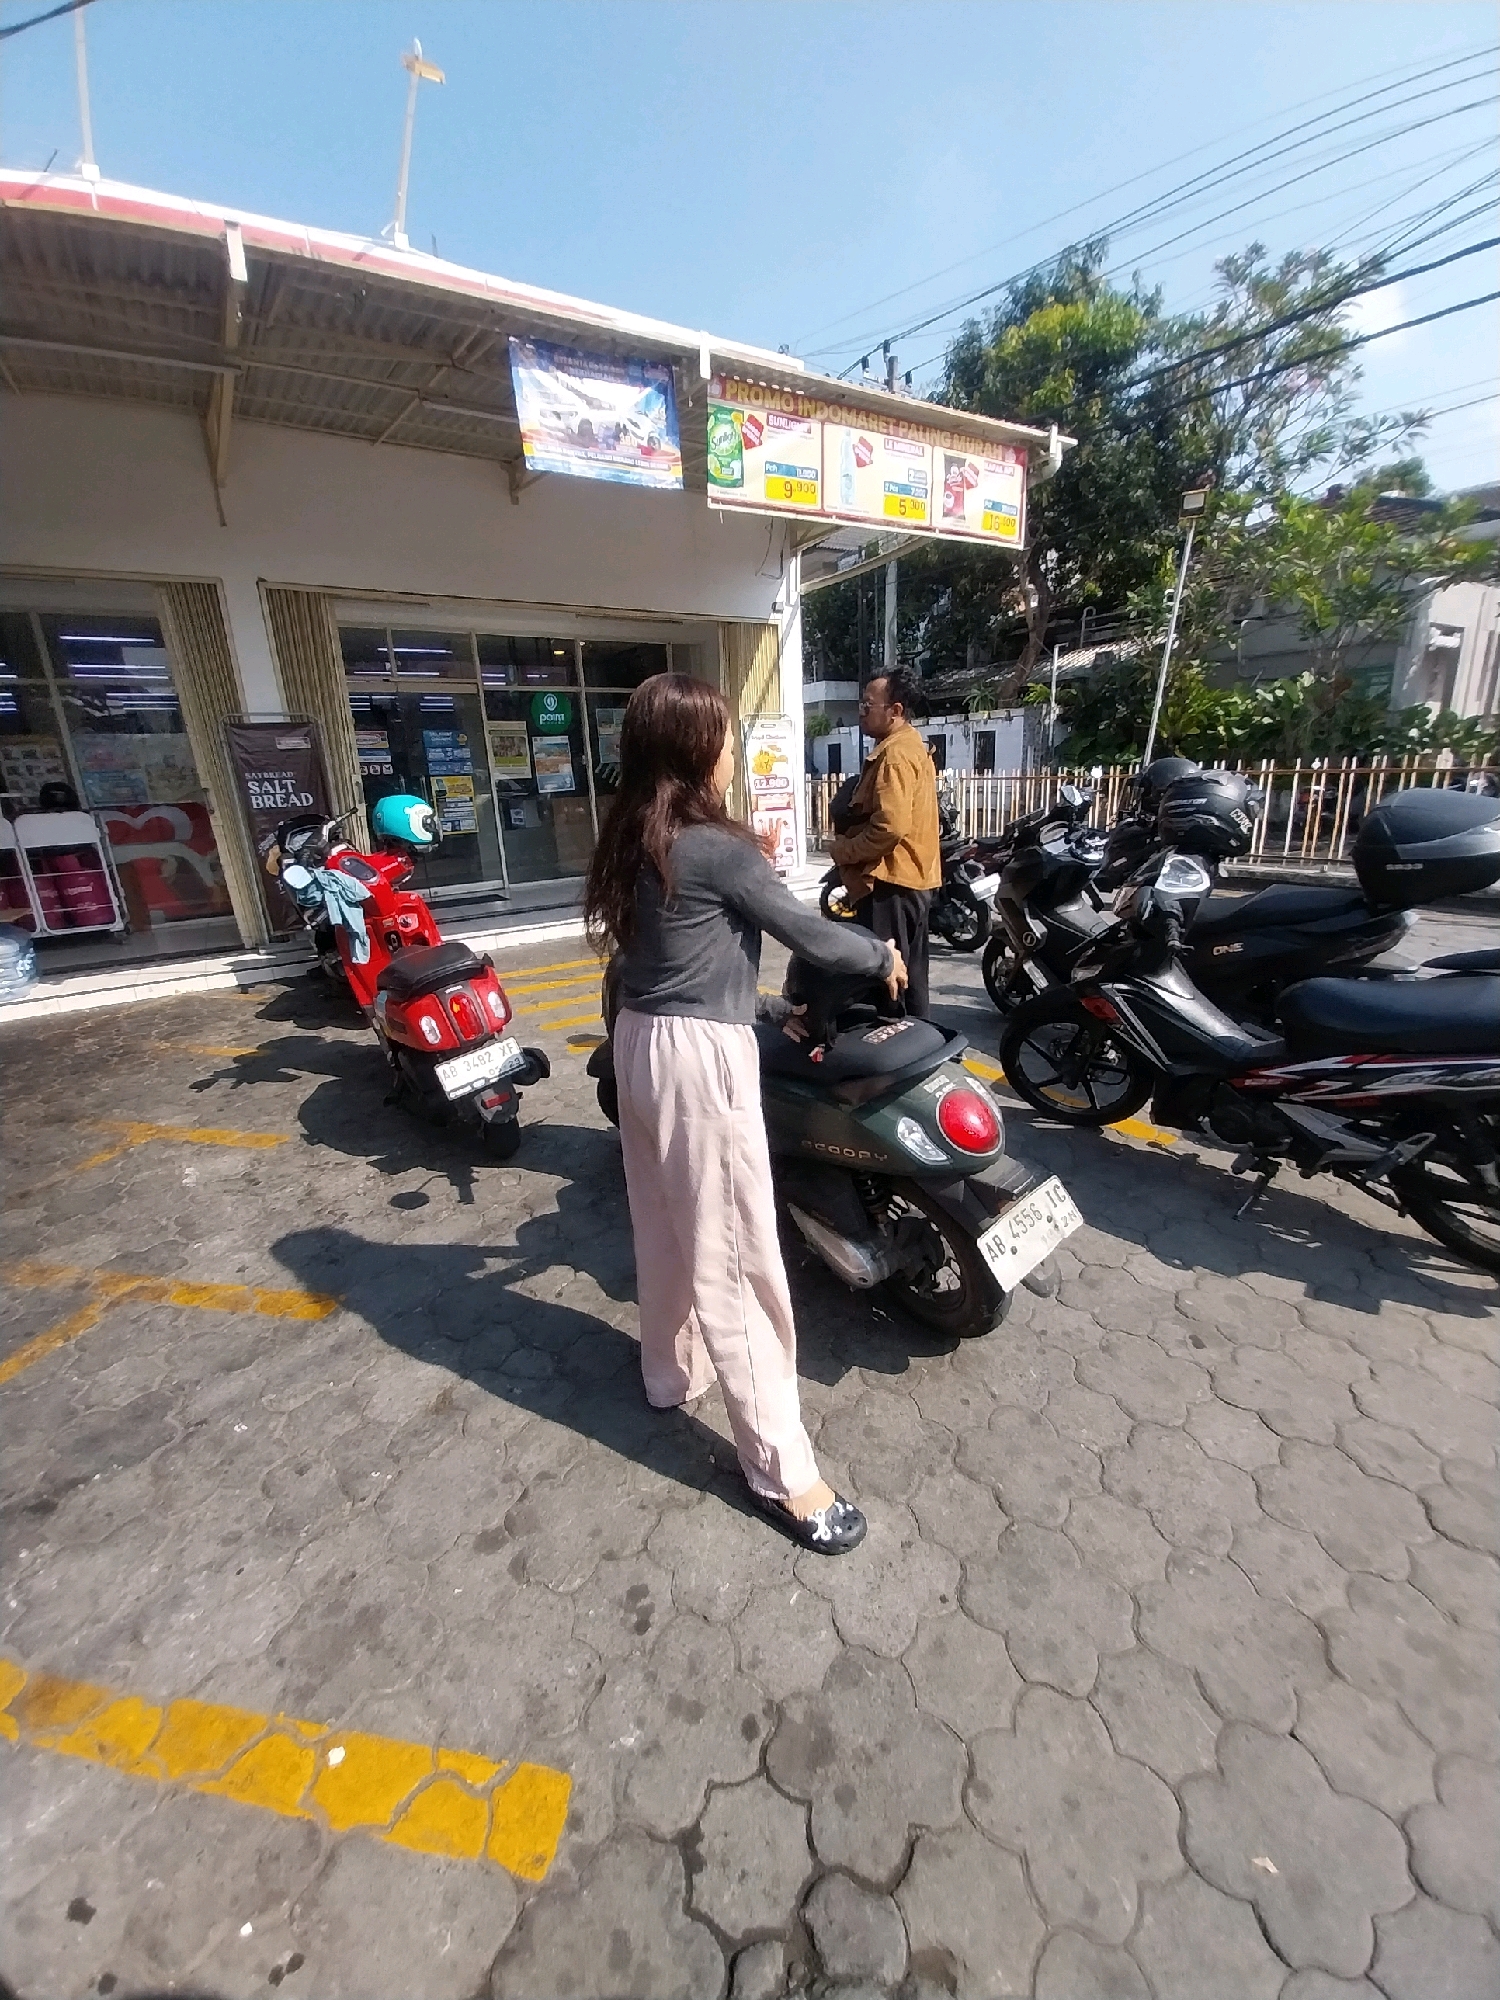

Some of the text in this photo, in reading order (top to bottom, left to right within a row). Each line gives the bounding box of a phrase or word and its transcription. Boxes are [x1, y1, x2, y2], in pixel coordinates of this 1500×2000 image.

[726, 379, 794, 412] PROMO
[798, 397, 897, 436] INDOMARET
[899, 420, 951, 448] PALING
[953, 433, 1003, 461] MURAH
[784, 481, 816, 499] 9.900
[247, 779, 296, 795] SALT
[250, 793, 314, 809] BREAD
[442, 1042, 514, 1081] AB 3482 XF
[985, 1234, 1006, 1262] AB
[1008, 1203, 1043, 1239] 4556
[1045, 1183, 1066, 1208] IC
